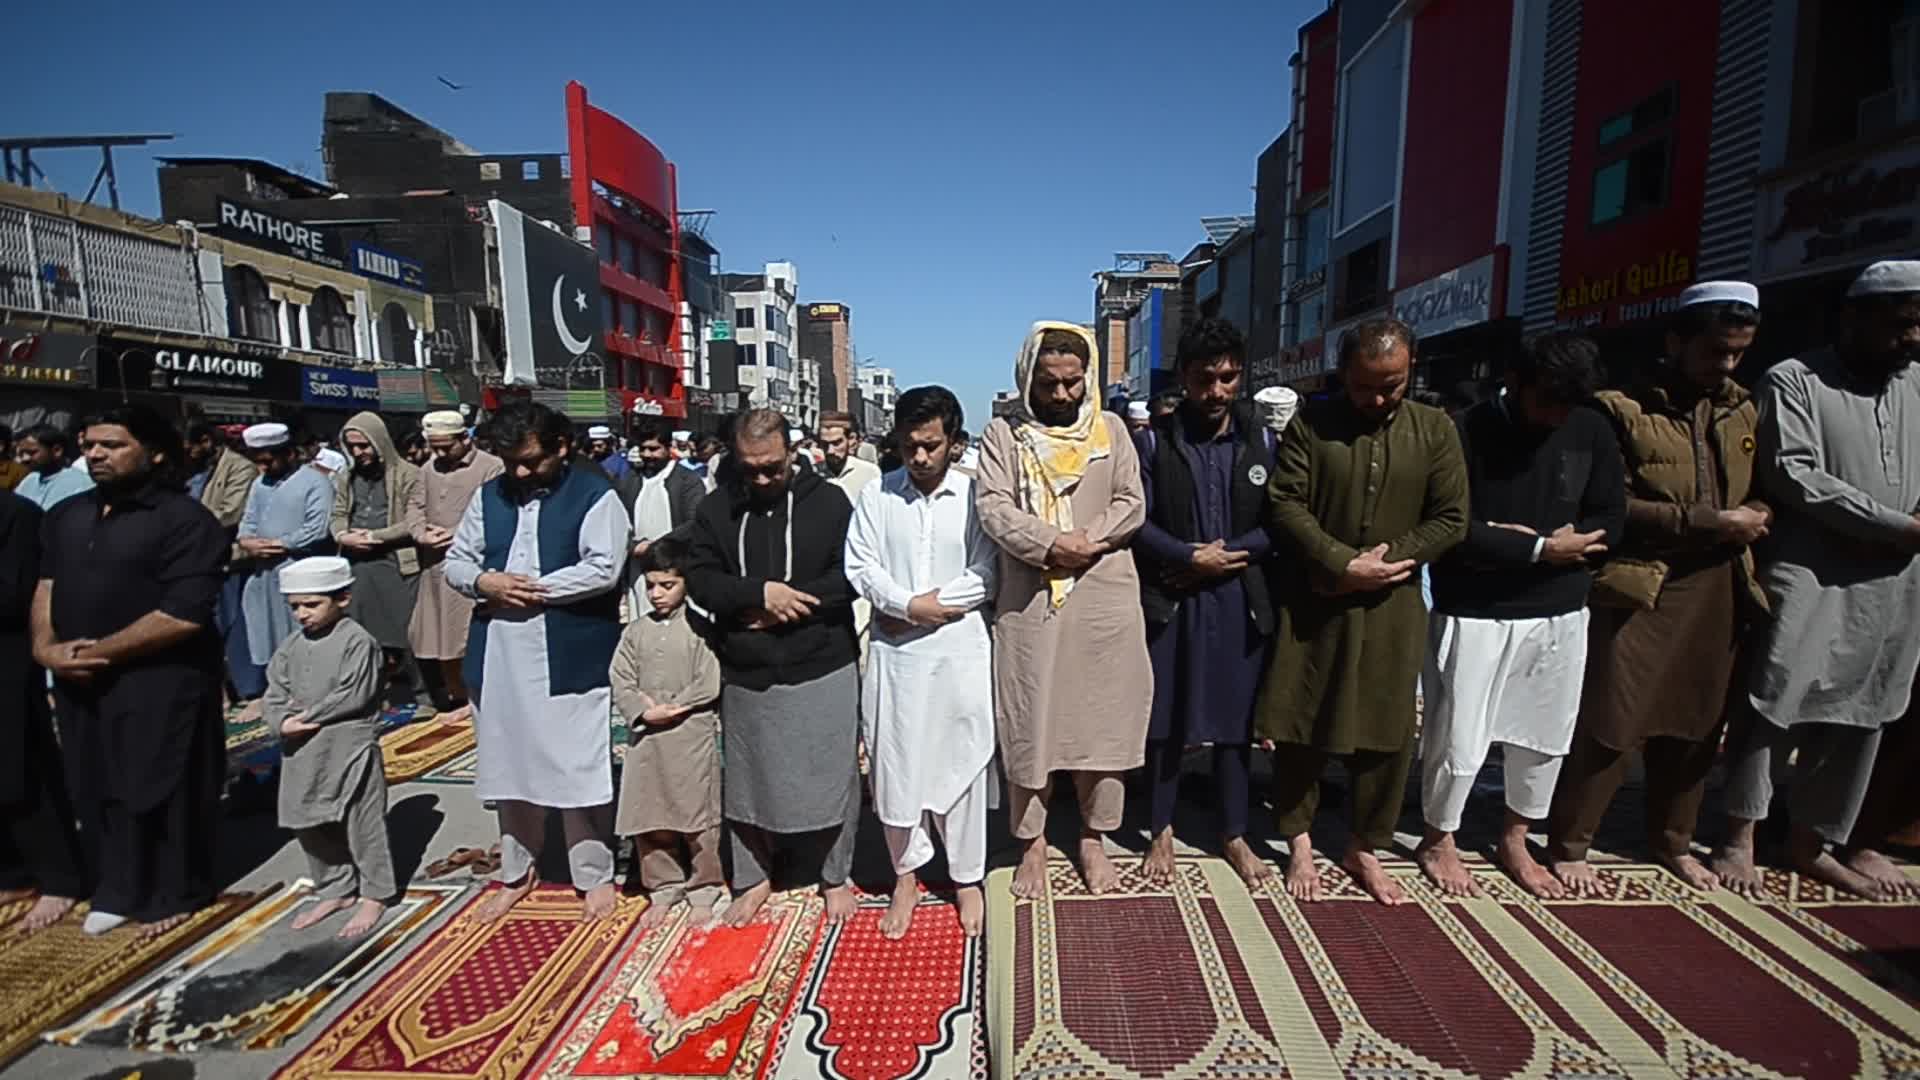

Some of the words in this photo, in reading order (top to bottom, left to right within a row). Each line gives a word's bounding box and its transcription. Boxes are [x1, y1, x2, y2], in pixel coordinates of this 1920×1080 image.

[220, 201, 325, 253] RATHORE
[155, 349, 264, 379] GLAMOUR
[309, 381, 349, 398] SWISS
